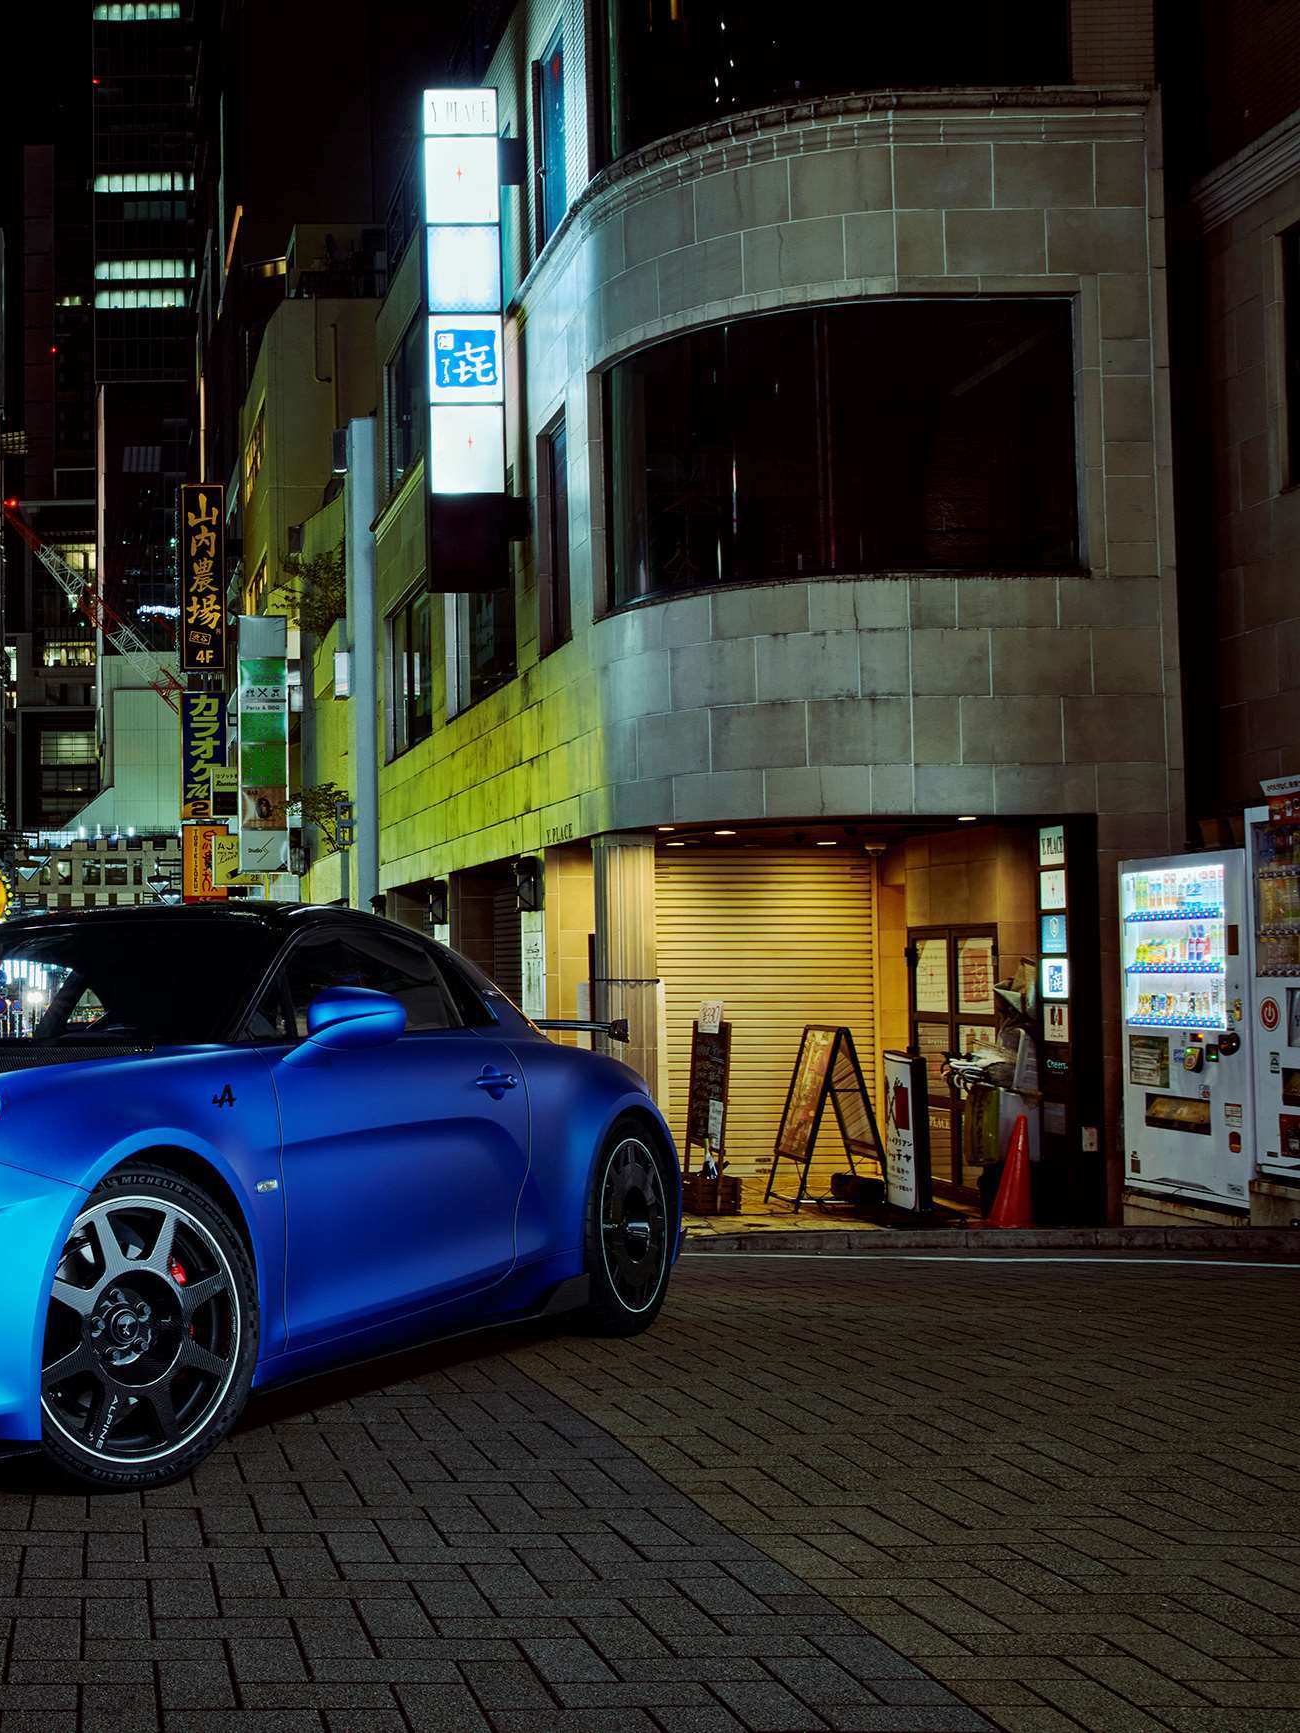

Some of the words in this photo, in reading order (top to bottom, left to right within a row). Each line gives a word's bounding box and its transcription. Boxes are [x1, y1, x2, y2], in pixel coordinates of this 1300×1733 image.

[186, 492, 222, 630] 山内農場
[195, 650, 214, 664] 4F
[189, 694, 222, 783] カラオケ
[120, 1174, 184, 1194] MICHELIN
[95, 1393, 119, 1450] ALPINE
